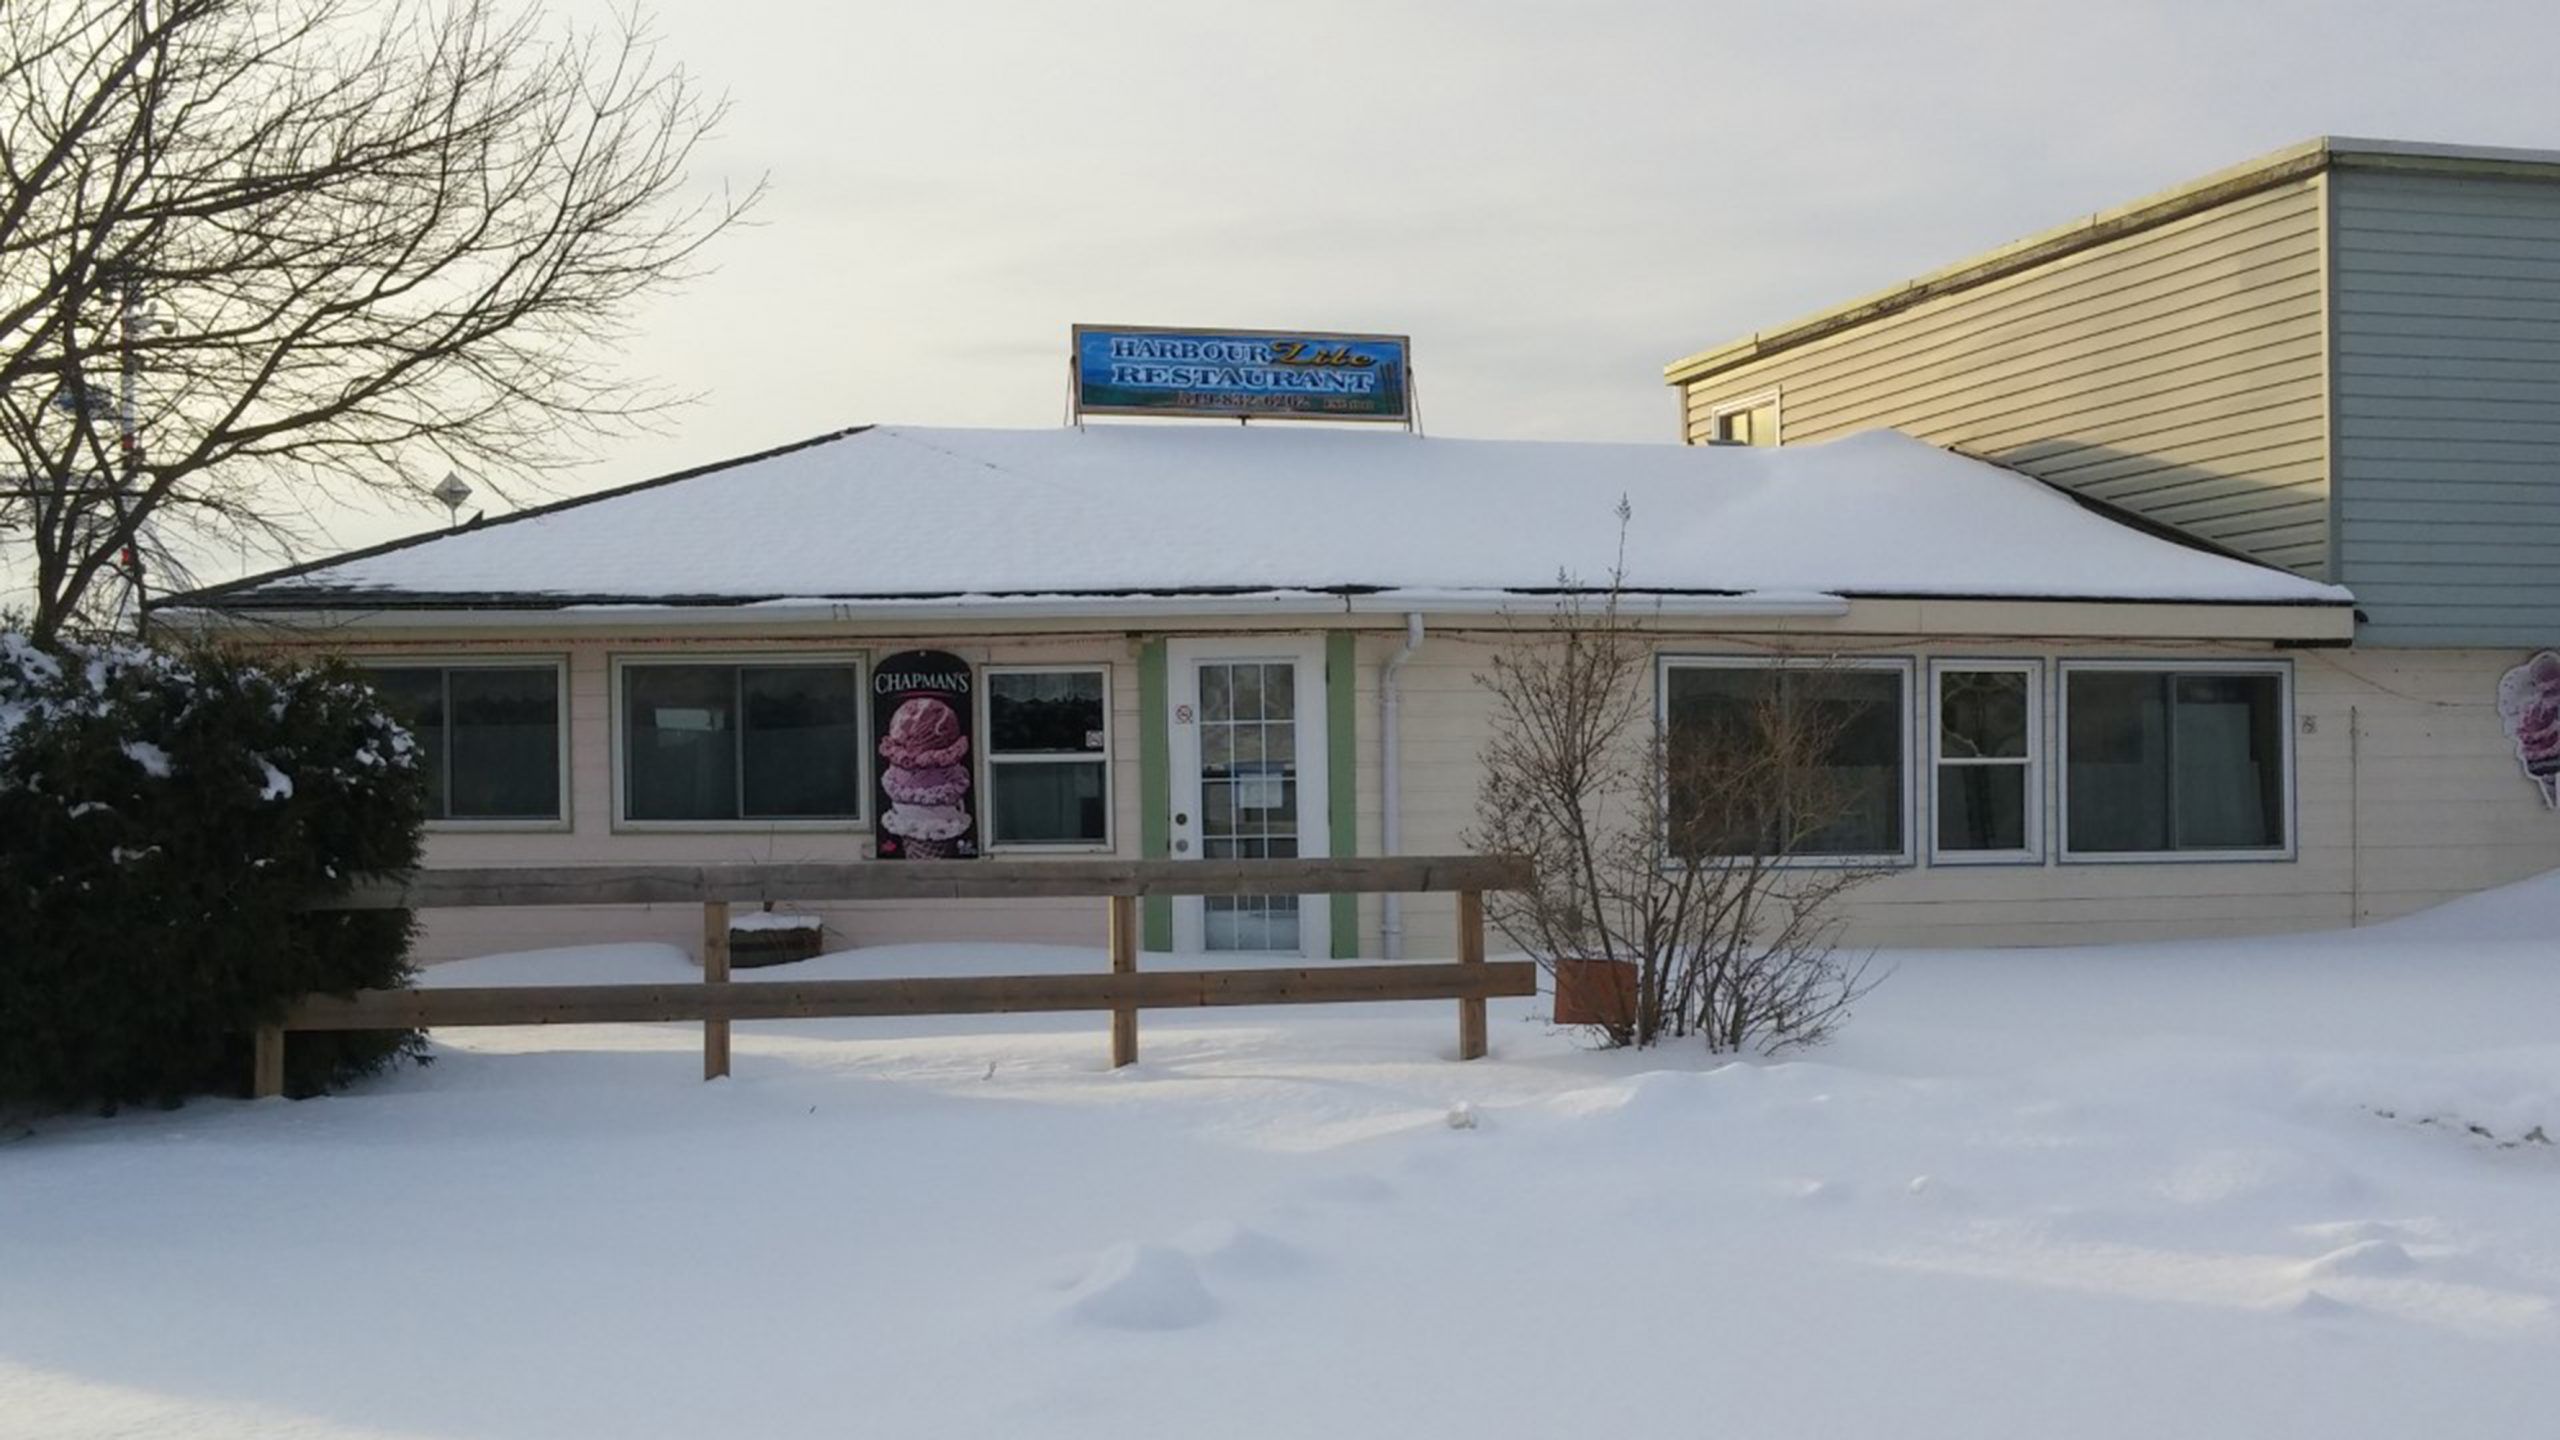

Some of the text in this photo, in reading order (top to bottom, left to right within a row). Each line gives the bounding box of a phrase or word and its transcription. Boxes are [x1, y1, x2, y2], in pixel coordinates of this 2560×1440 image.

[1112, 337, 1271, 364] HARBOUR
[1112, 363, 1374, 393] RESTAURANT
[875, 672, 969, 694] CHAPMAN'S
